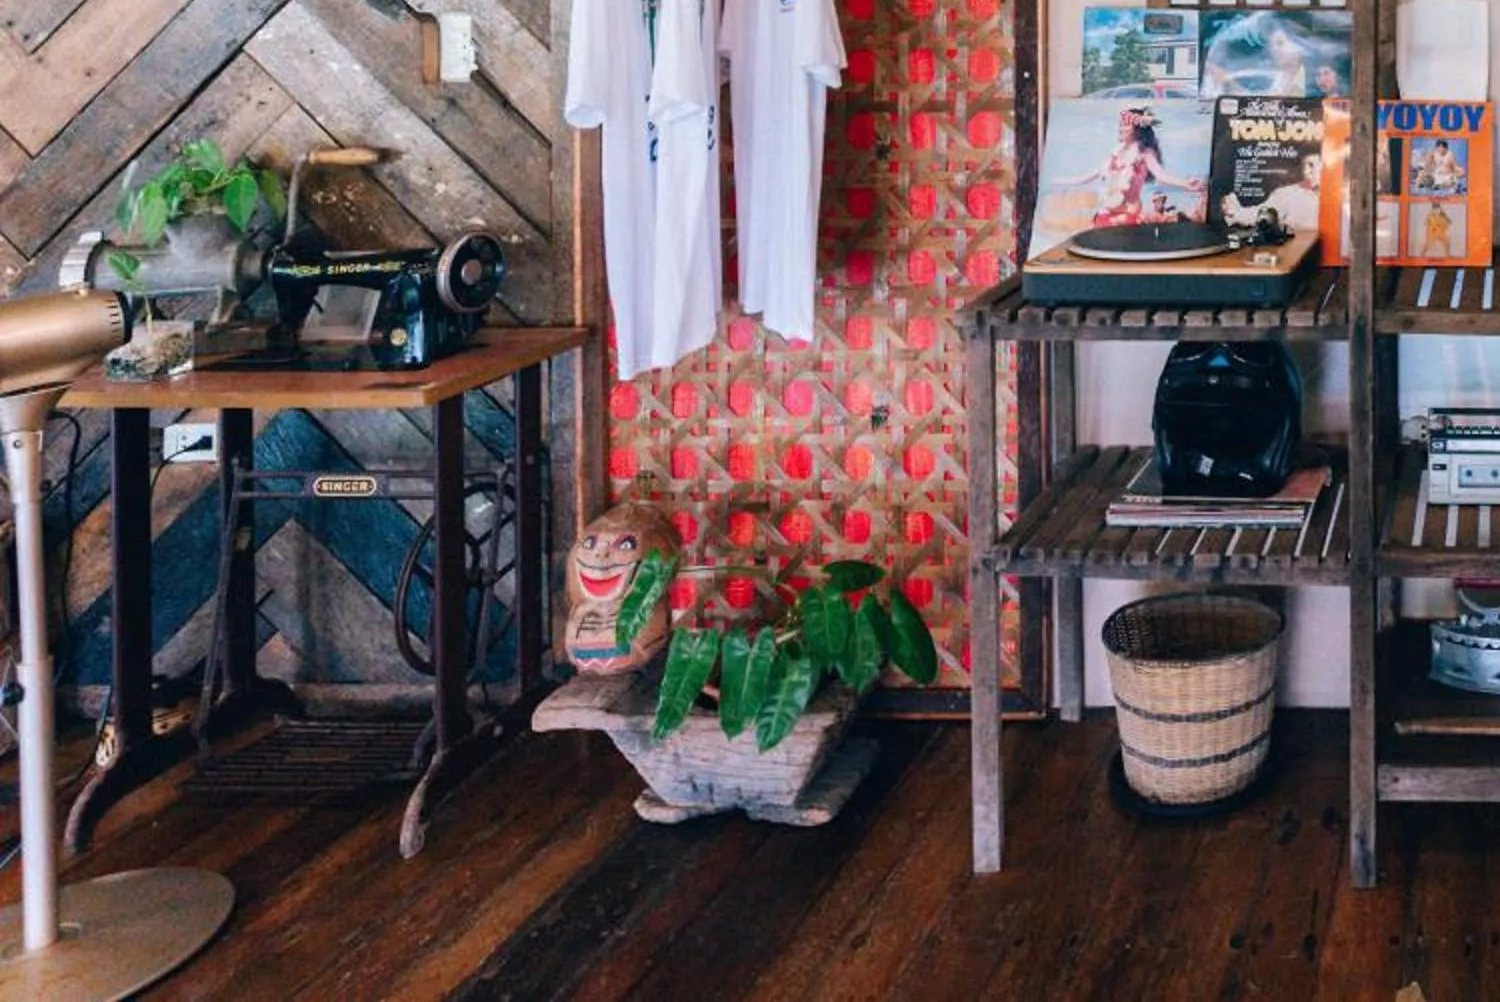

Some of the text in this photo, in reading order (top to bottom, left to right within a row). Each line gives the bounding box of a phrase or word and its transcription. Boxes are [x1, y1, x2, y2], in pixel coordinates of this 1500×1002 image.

[1377, 102, 1485, 132] YOYOY
[1229, 118, 1277, 141] TOM
[327, 261, 371, 275] SINGER
[321, 481, 369, 491] SINGER
